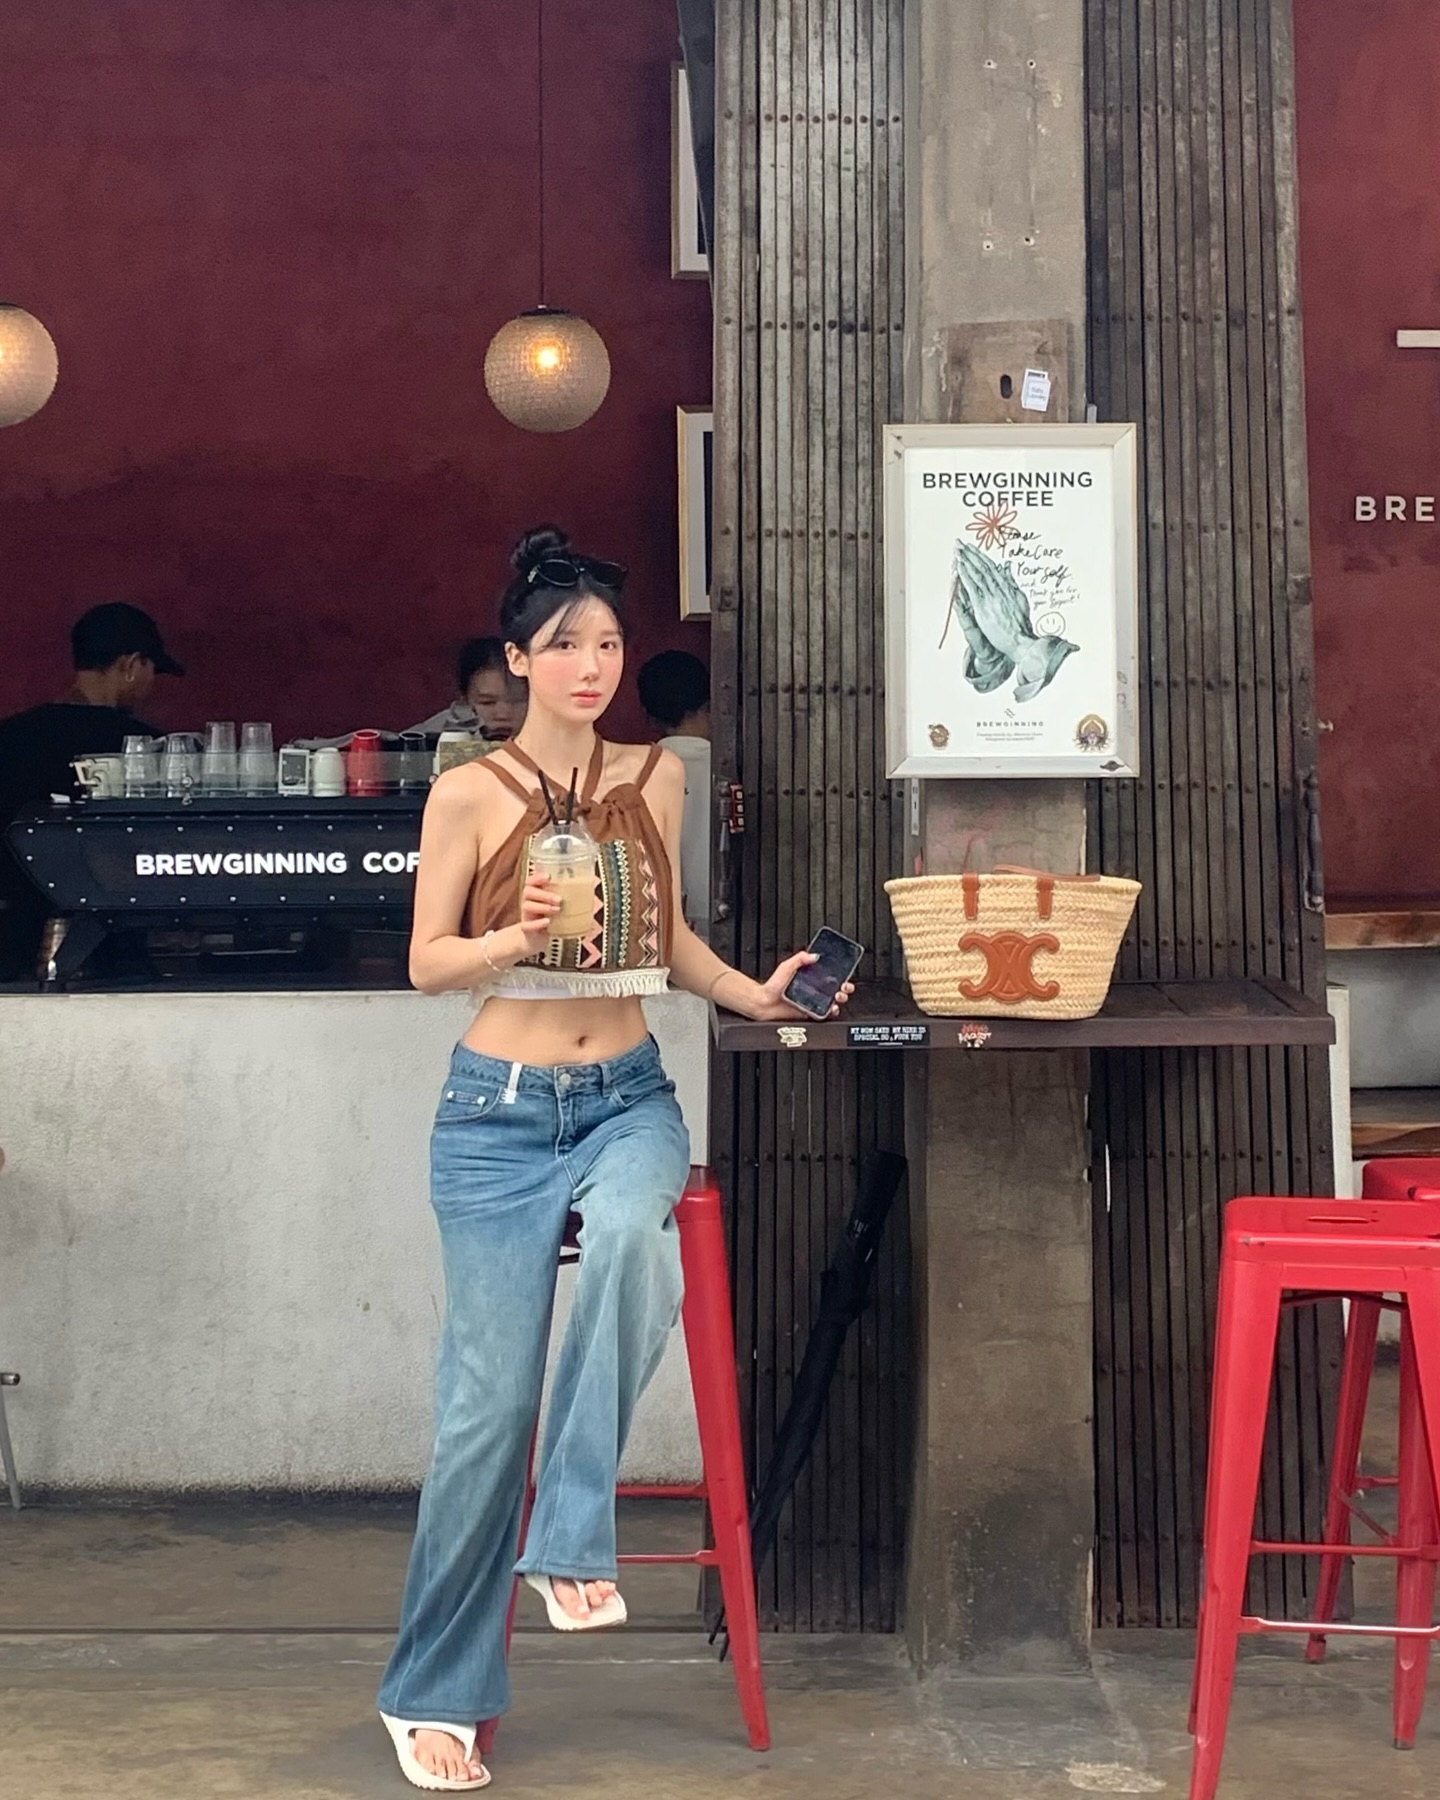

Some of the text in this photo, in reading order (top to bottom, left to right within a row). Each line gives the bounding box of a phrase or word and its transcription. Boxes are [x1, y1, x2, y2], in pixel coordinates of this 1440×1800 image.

[923, 471, 1093, 488] BREWGINNING
[962, 490, 1054, 507] COFFEE
[1355, 496, 1435, 521] BRE
[136, 852, 347, 876] BREWGINNING
